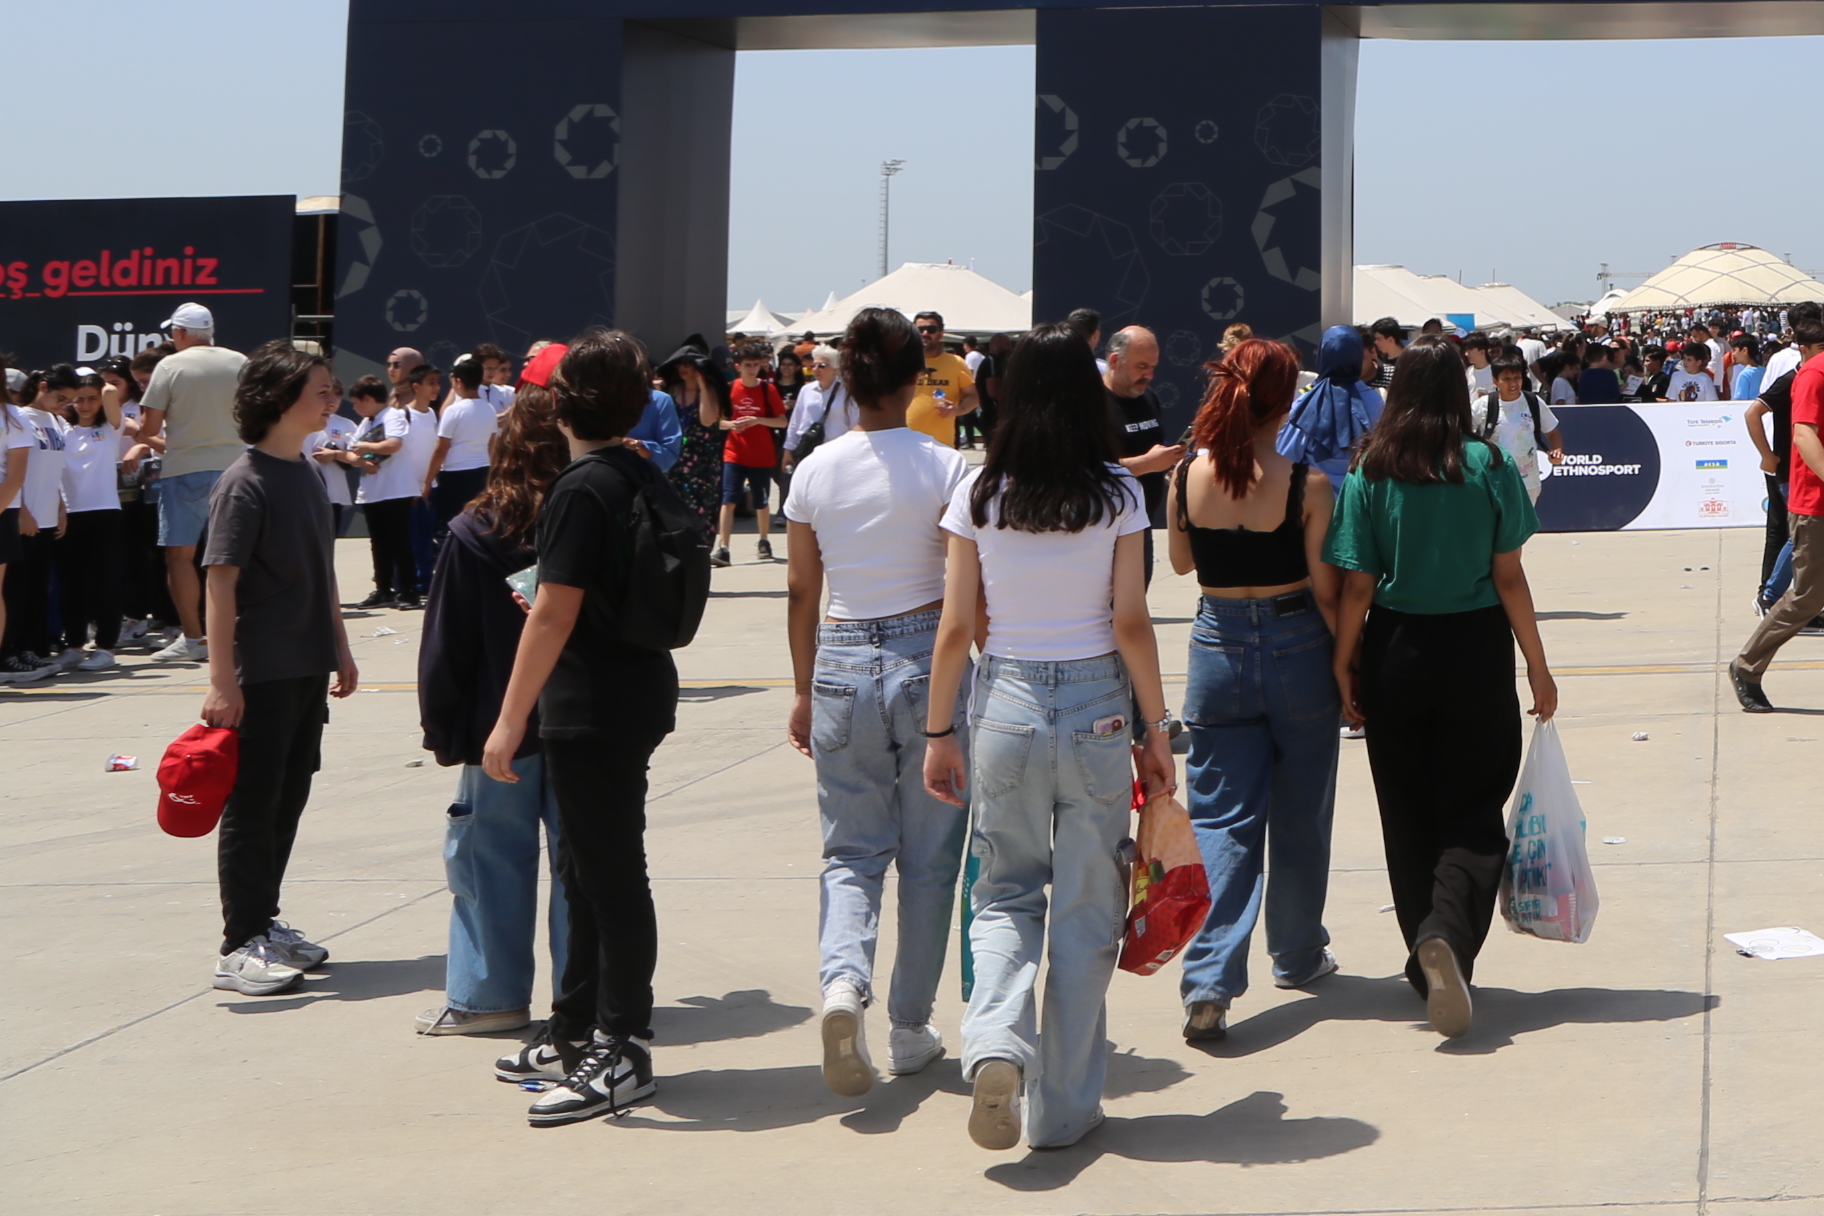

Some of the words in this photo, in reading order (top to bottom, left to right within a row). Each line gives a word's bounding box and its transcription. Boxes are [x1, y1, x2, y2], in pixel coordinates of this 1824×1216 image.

[42, 245, 220, 298] geldiniz
[76, 321, 176, 362] Dün
[1552, 464, 1642, 477] ETHNOSPORT
